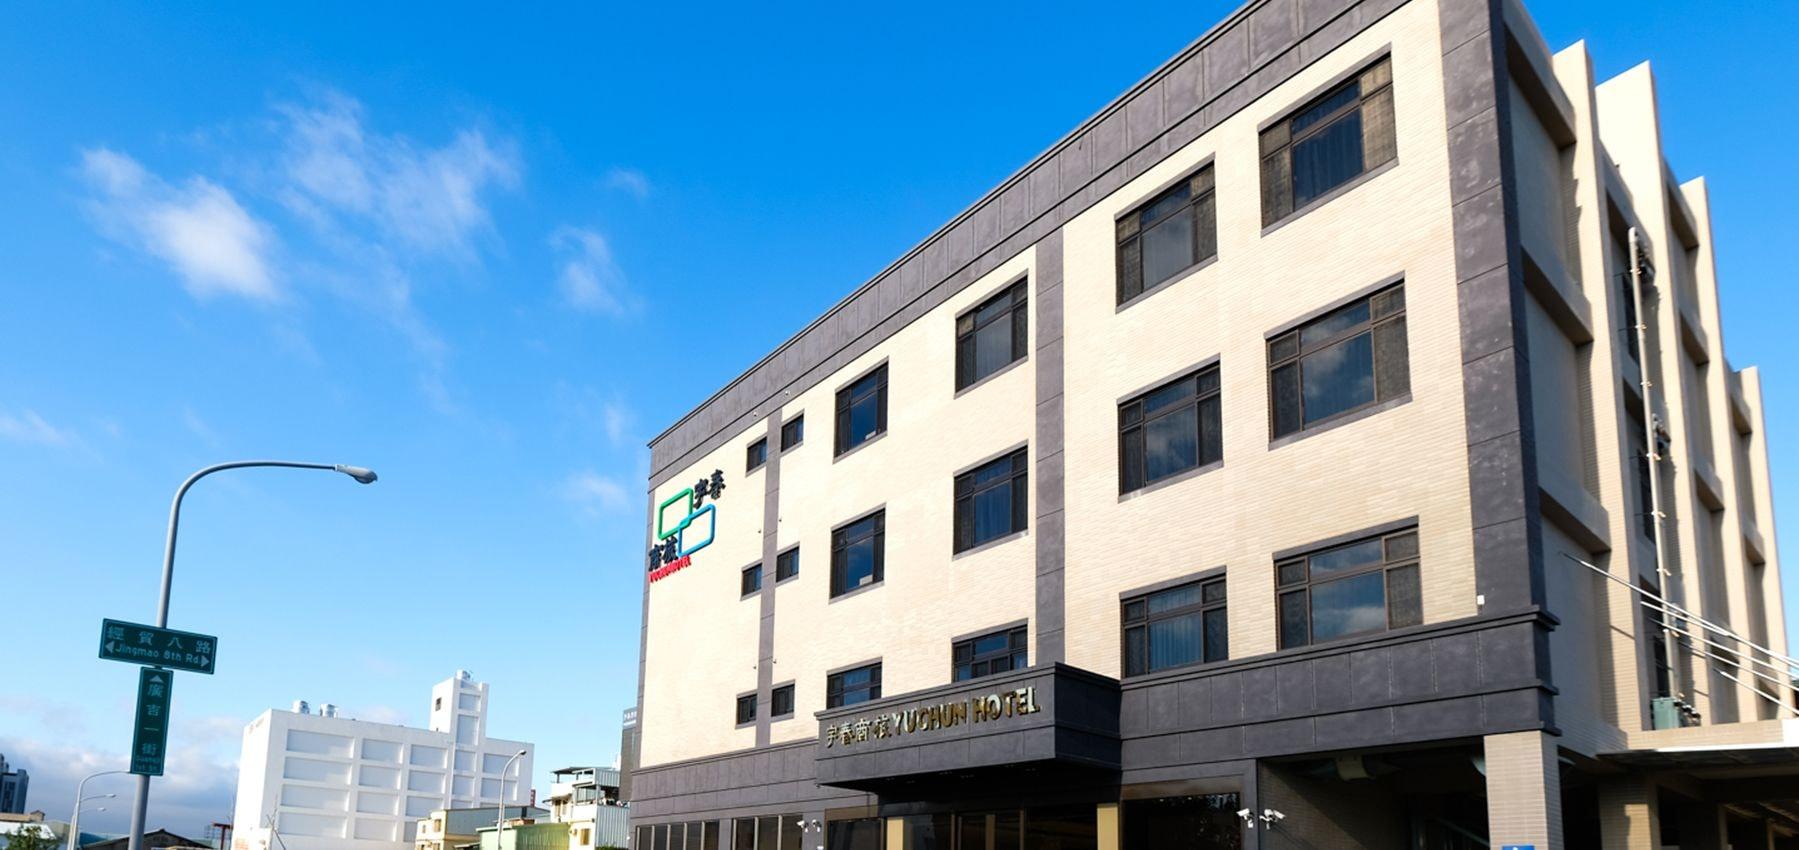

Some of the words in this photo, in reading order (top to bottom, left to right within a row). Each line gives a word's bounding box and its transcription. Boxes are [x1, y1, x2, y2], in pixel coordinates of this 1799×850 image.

[107, 625, 211, 655] 經貿八路
[115, 644, 159, 658] Jingmao
[163, 651, 182, 662] 8th
[892, 701, 968, 735] YUCHUN
[972, 686, 1041, 723] HOTEL
